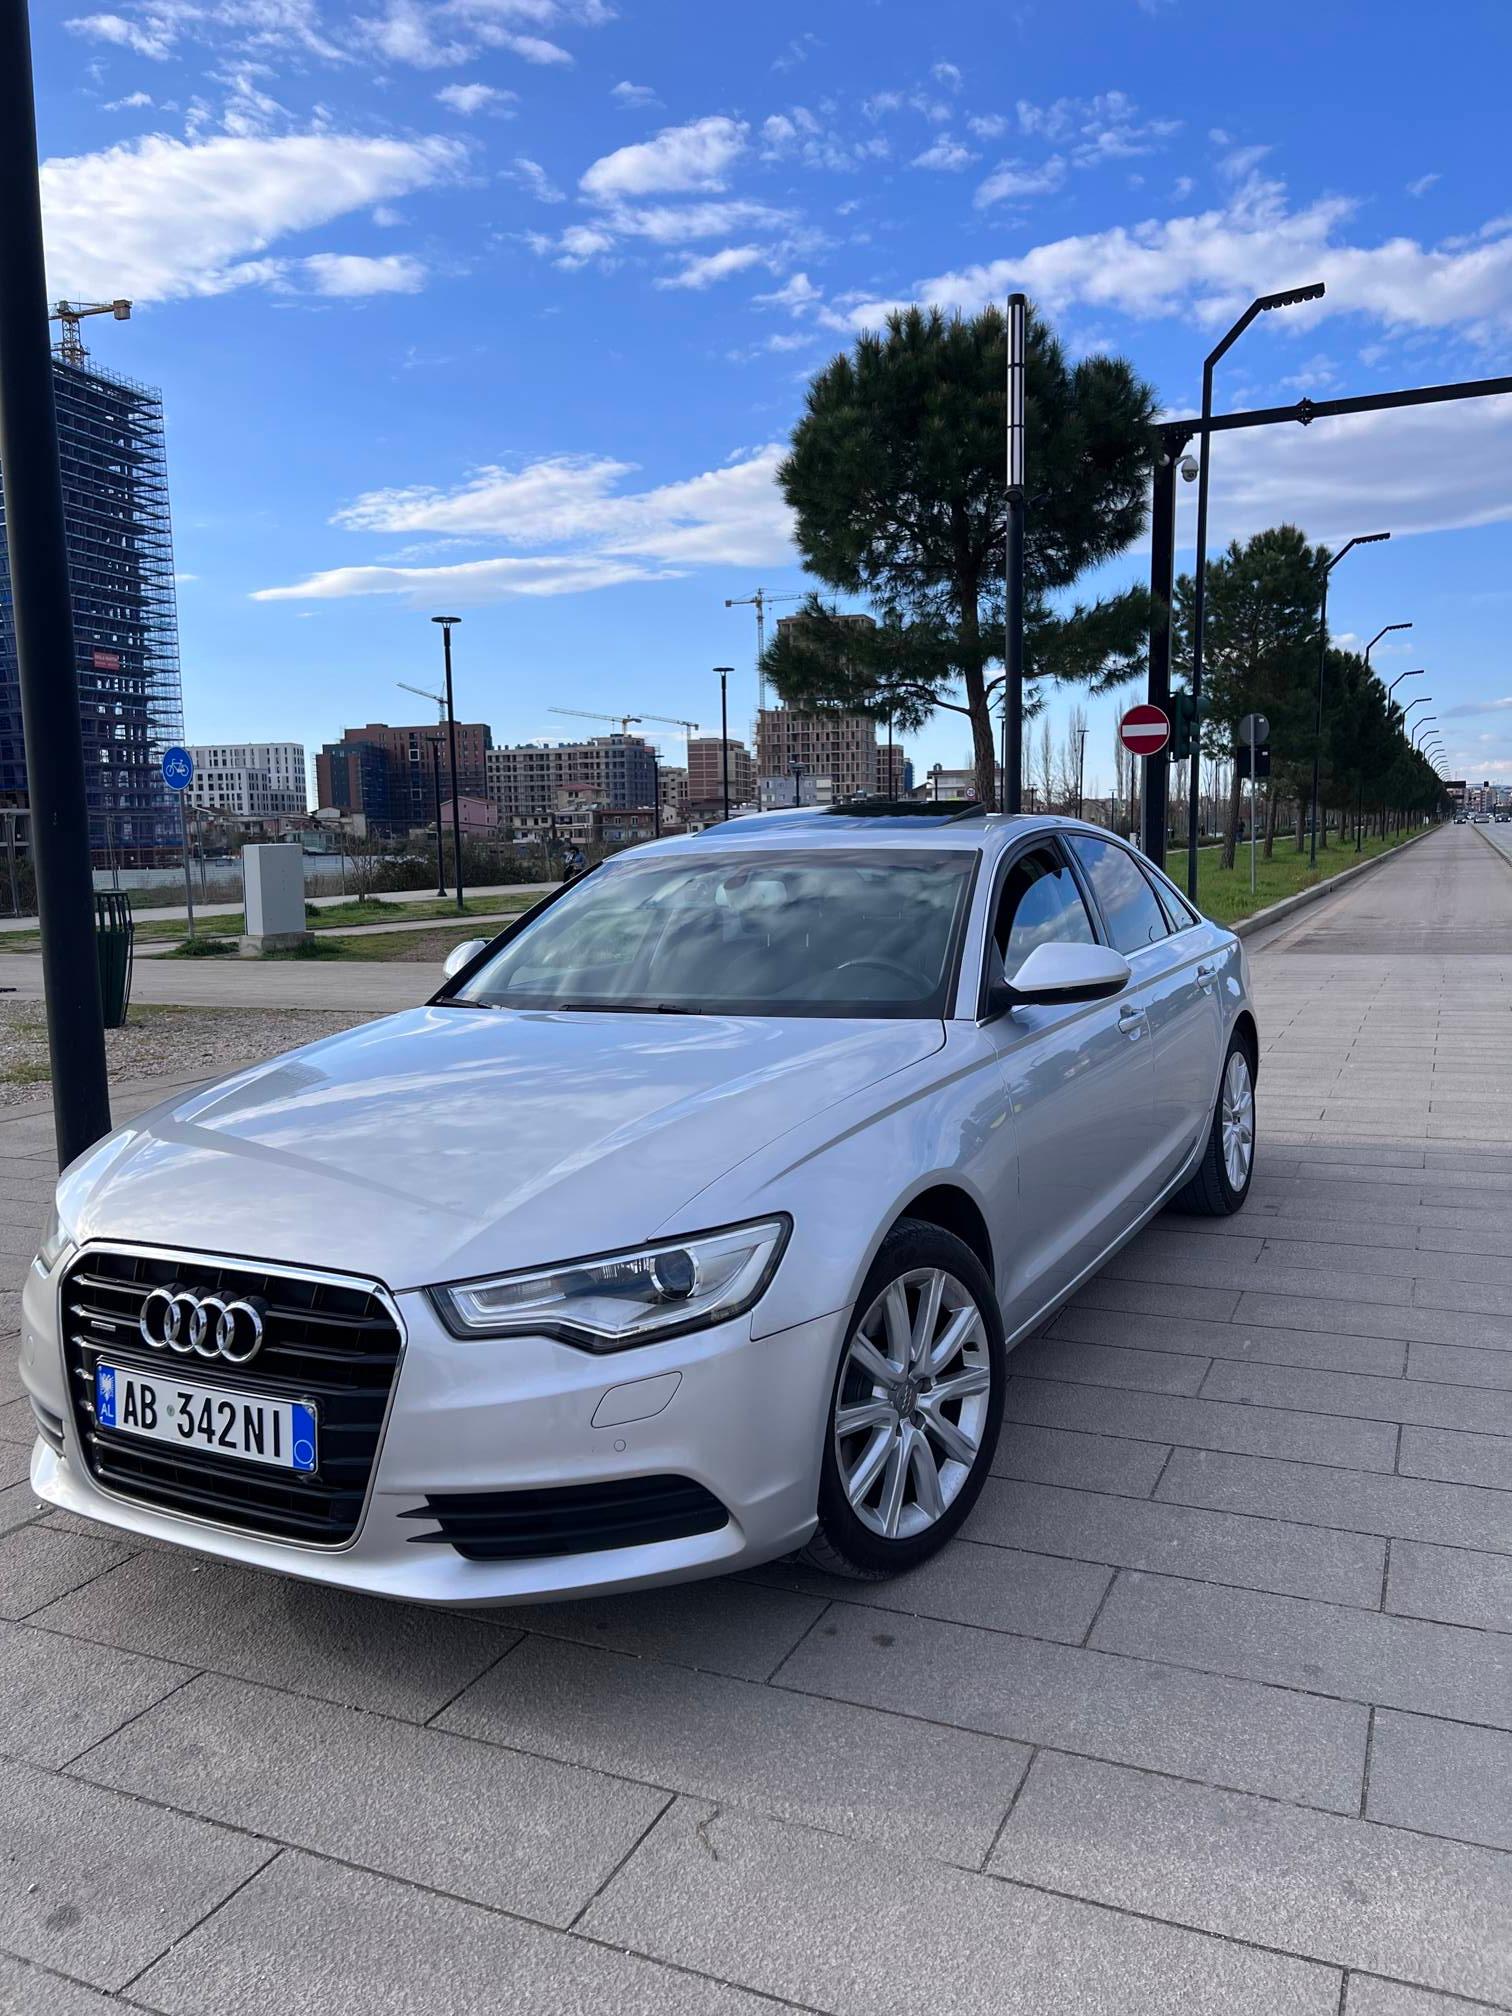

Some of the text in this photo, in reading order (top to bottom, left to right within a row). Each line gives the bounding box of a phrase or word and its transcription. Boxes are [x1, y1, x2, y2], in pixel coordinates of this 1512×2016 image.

[100, 1403, 115, 1418] AL
[123, 1380, 281, 1458] AB 342NI
